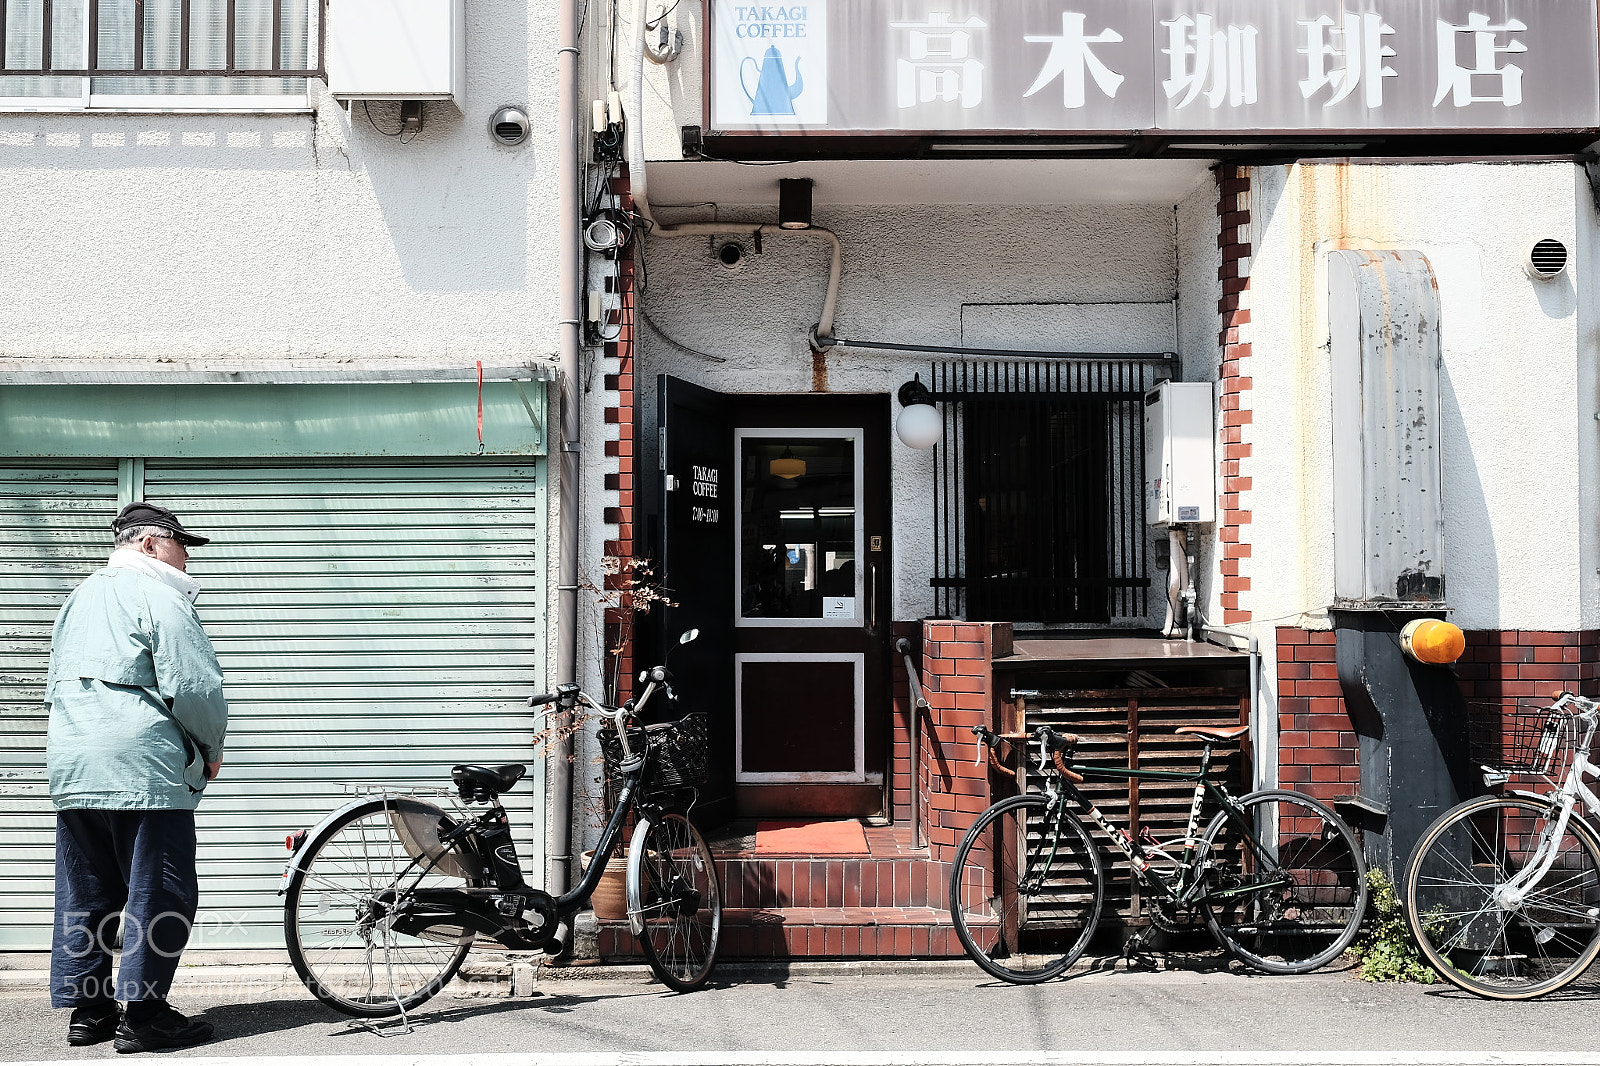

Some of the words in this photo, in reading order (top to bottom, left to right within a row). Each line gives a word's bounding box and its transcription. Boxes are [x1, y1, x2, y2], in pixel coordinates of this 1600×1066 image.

[735, 6, 808, 21] TAKAGI
[735, 23, 806, 38] COFFEE
[889, 12, 1529, 109] 高木珈琲店
[692, 465, 718, 483] TAKAGI
[692, 481, 718, 498] COFFEE
